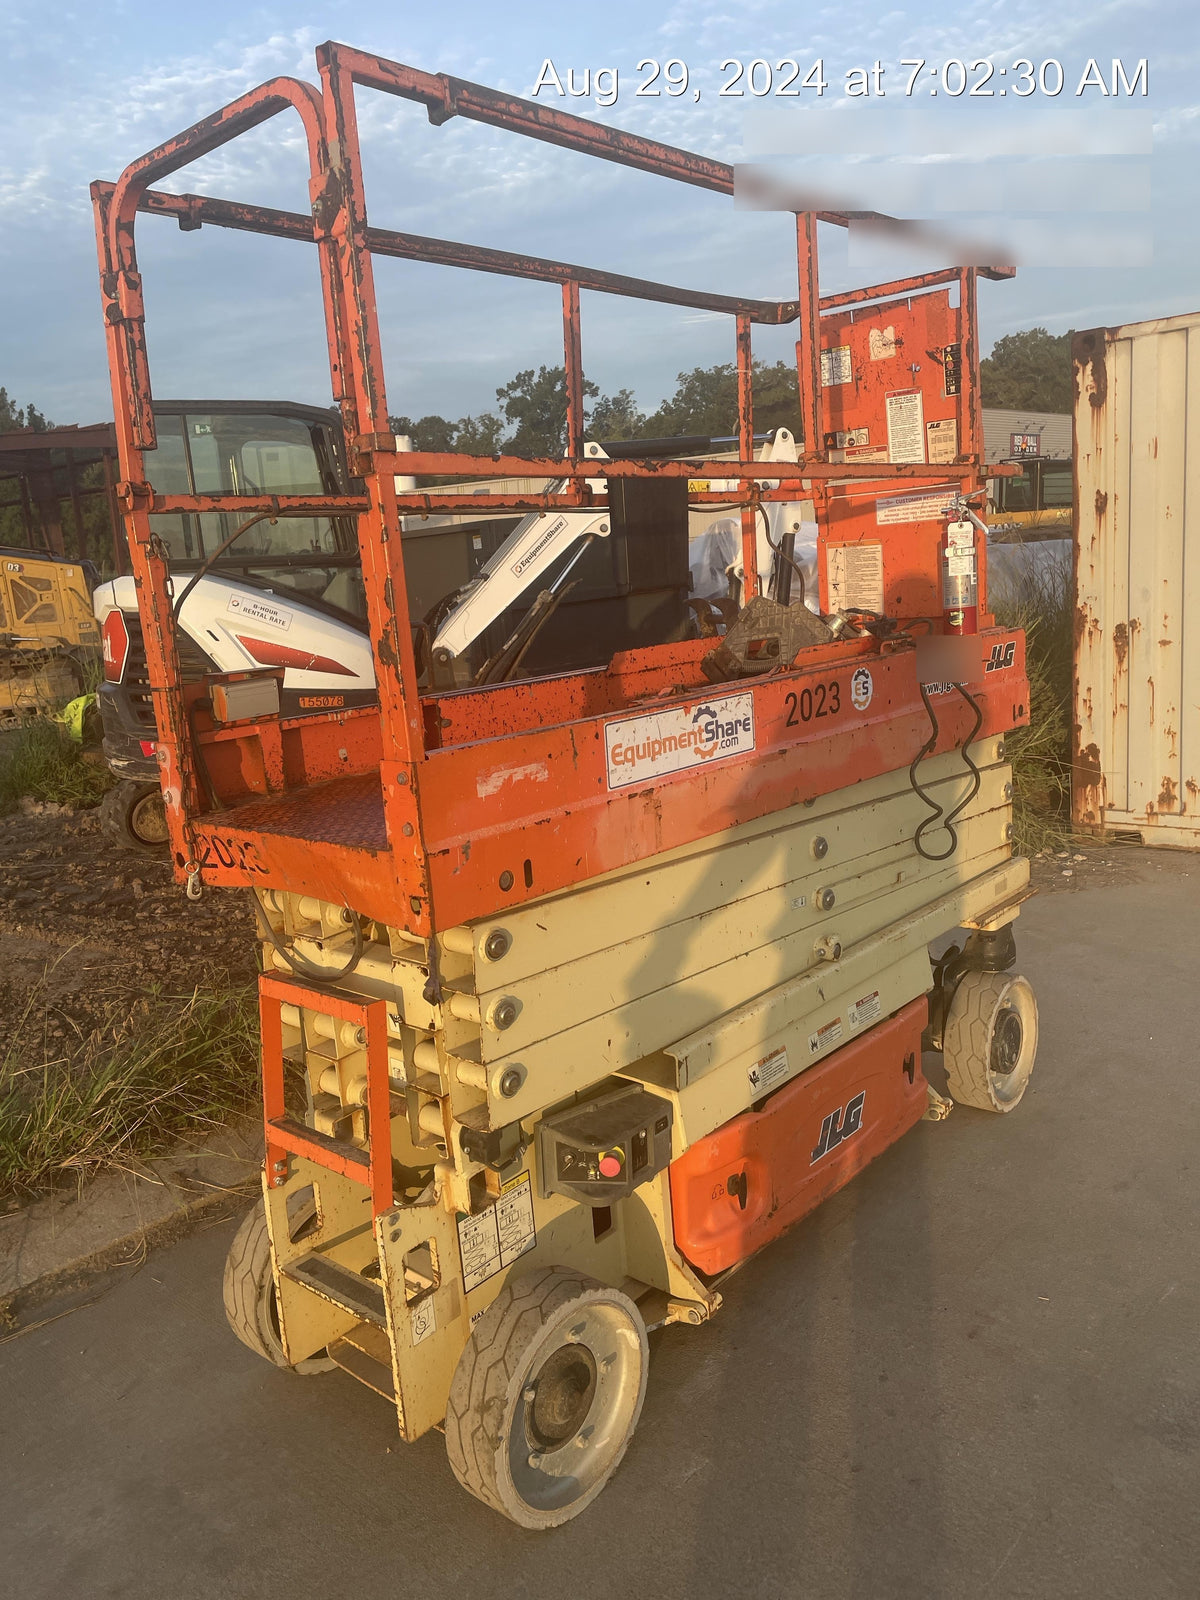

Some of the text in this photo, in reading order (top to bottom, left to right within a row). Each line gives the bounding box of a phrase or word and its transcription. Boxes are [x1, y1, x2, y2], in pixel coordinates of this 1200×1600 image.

[520, 521, 564, 567] EquipmentShare
[7, 562, 20, 572] D3
[243, 607, 286, 627] RENTAL RATE
[985, 641, 1016, 673] JLG
[301, 697, 344, 708] 155078
[785, 681, 841, 728] 2023
[611, 717, 751, 768] EquipmentShare
[719, 736, 739, 750] .com
[810, 1090, 866, 1167] JLG
[471, 1309, 485, 1323] MAX
